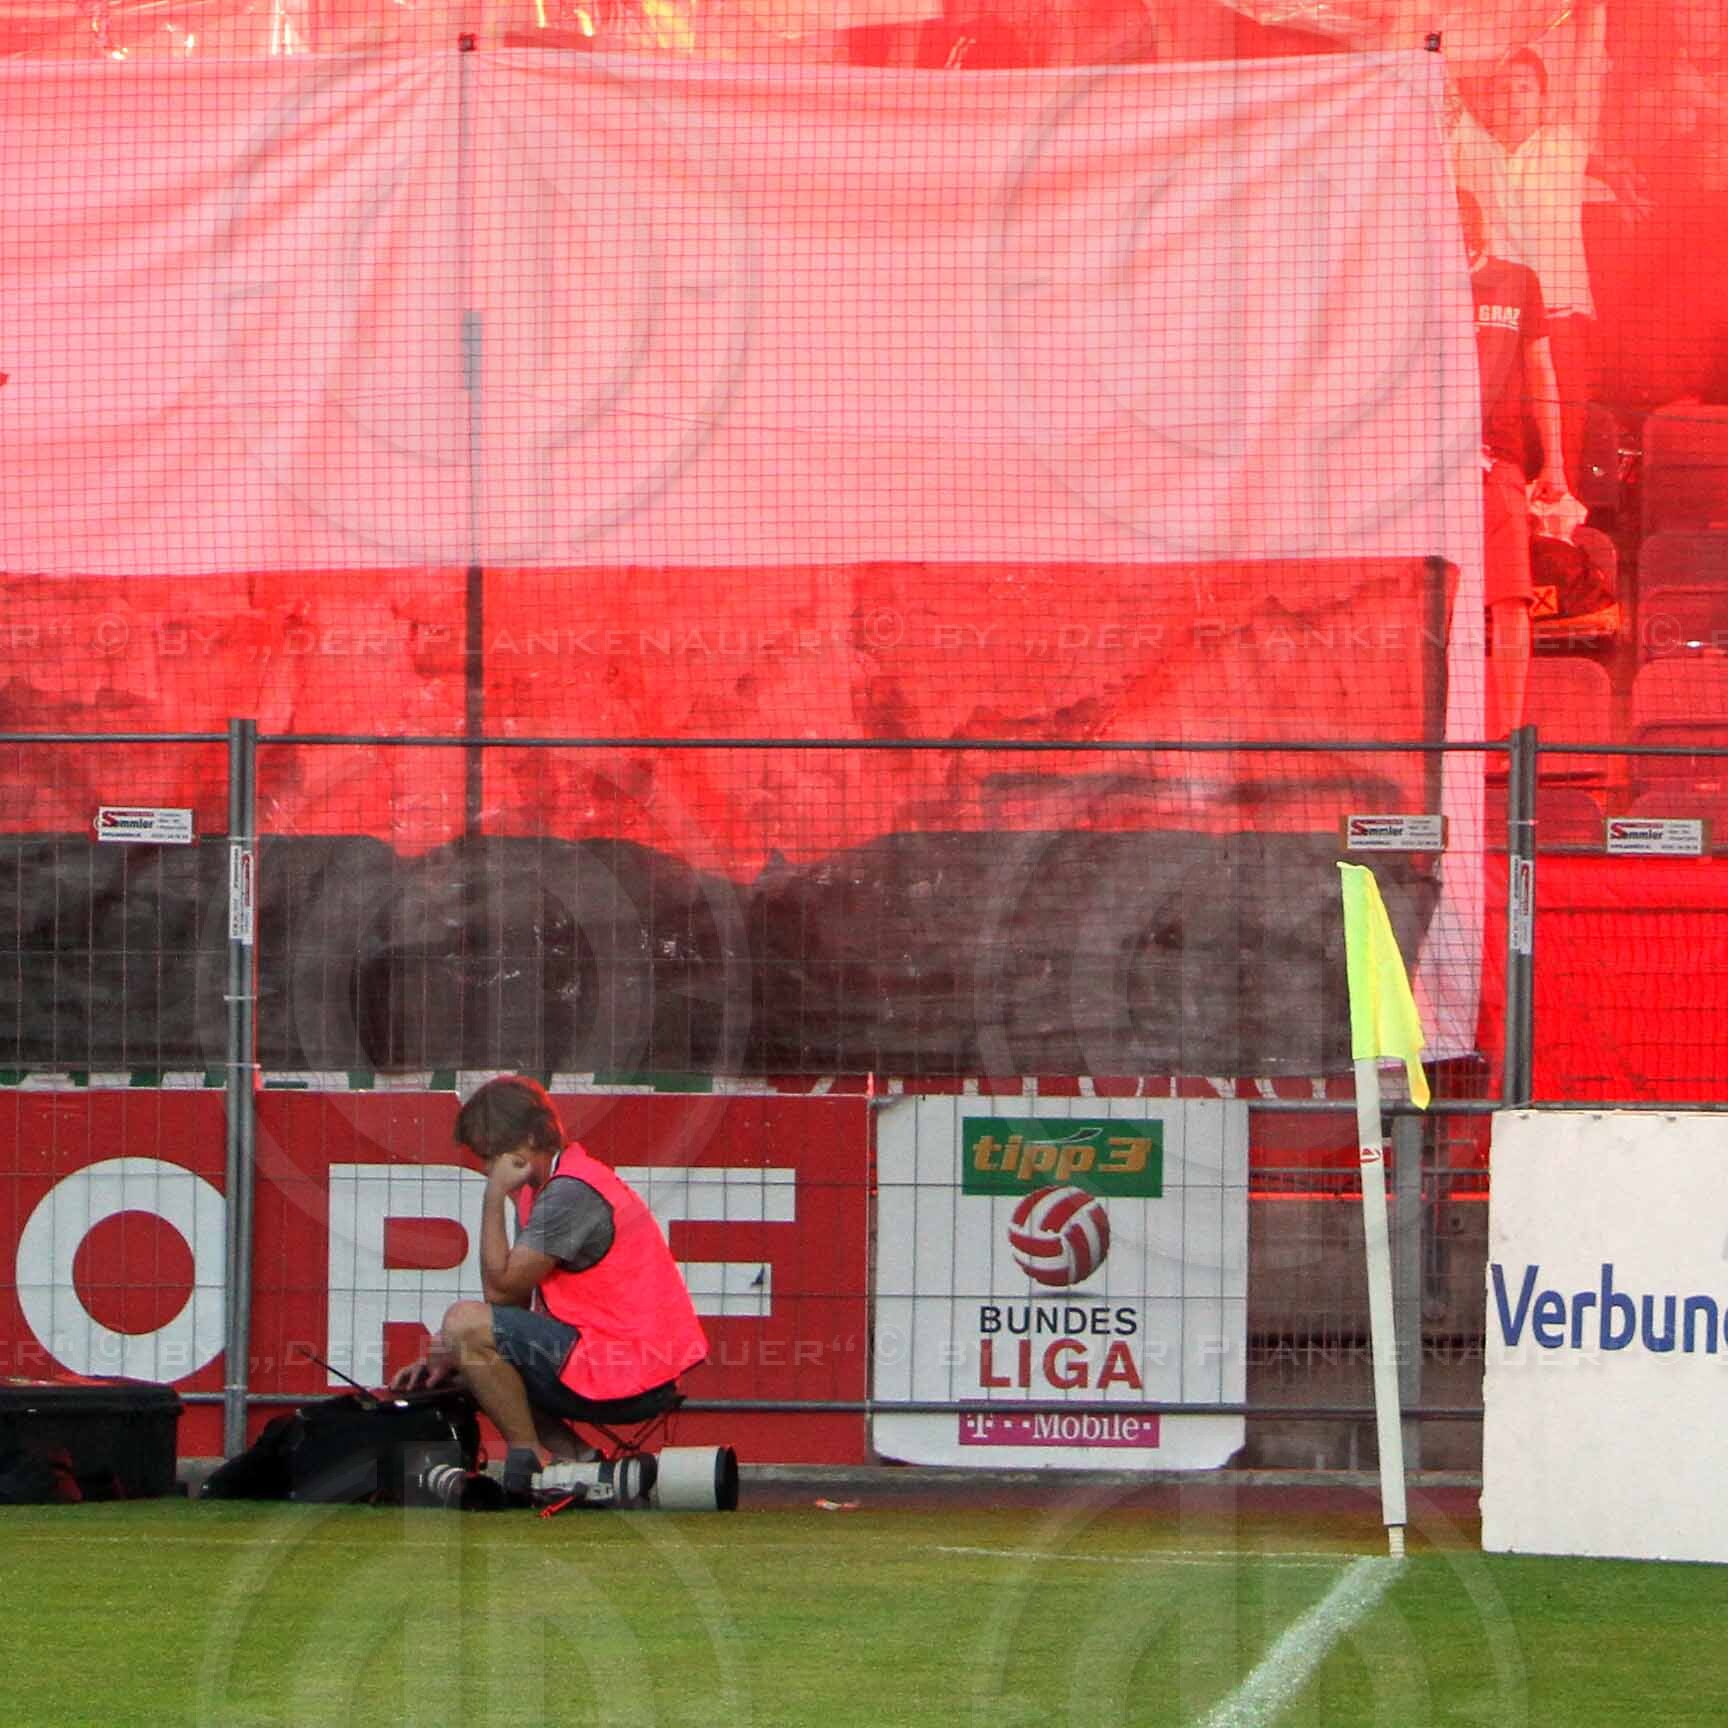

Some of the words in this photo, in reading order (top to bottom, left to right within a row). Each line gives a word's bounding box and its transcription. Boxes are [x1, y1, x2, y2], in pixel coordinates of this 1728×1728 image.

[972, 1133, 1152, 1181] tipp3
[980, 1306, 1138, 1335] BUNDES
[979, 1338, 1144, 1390] LIGA
